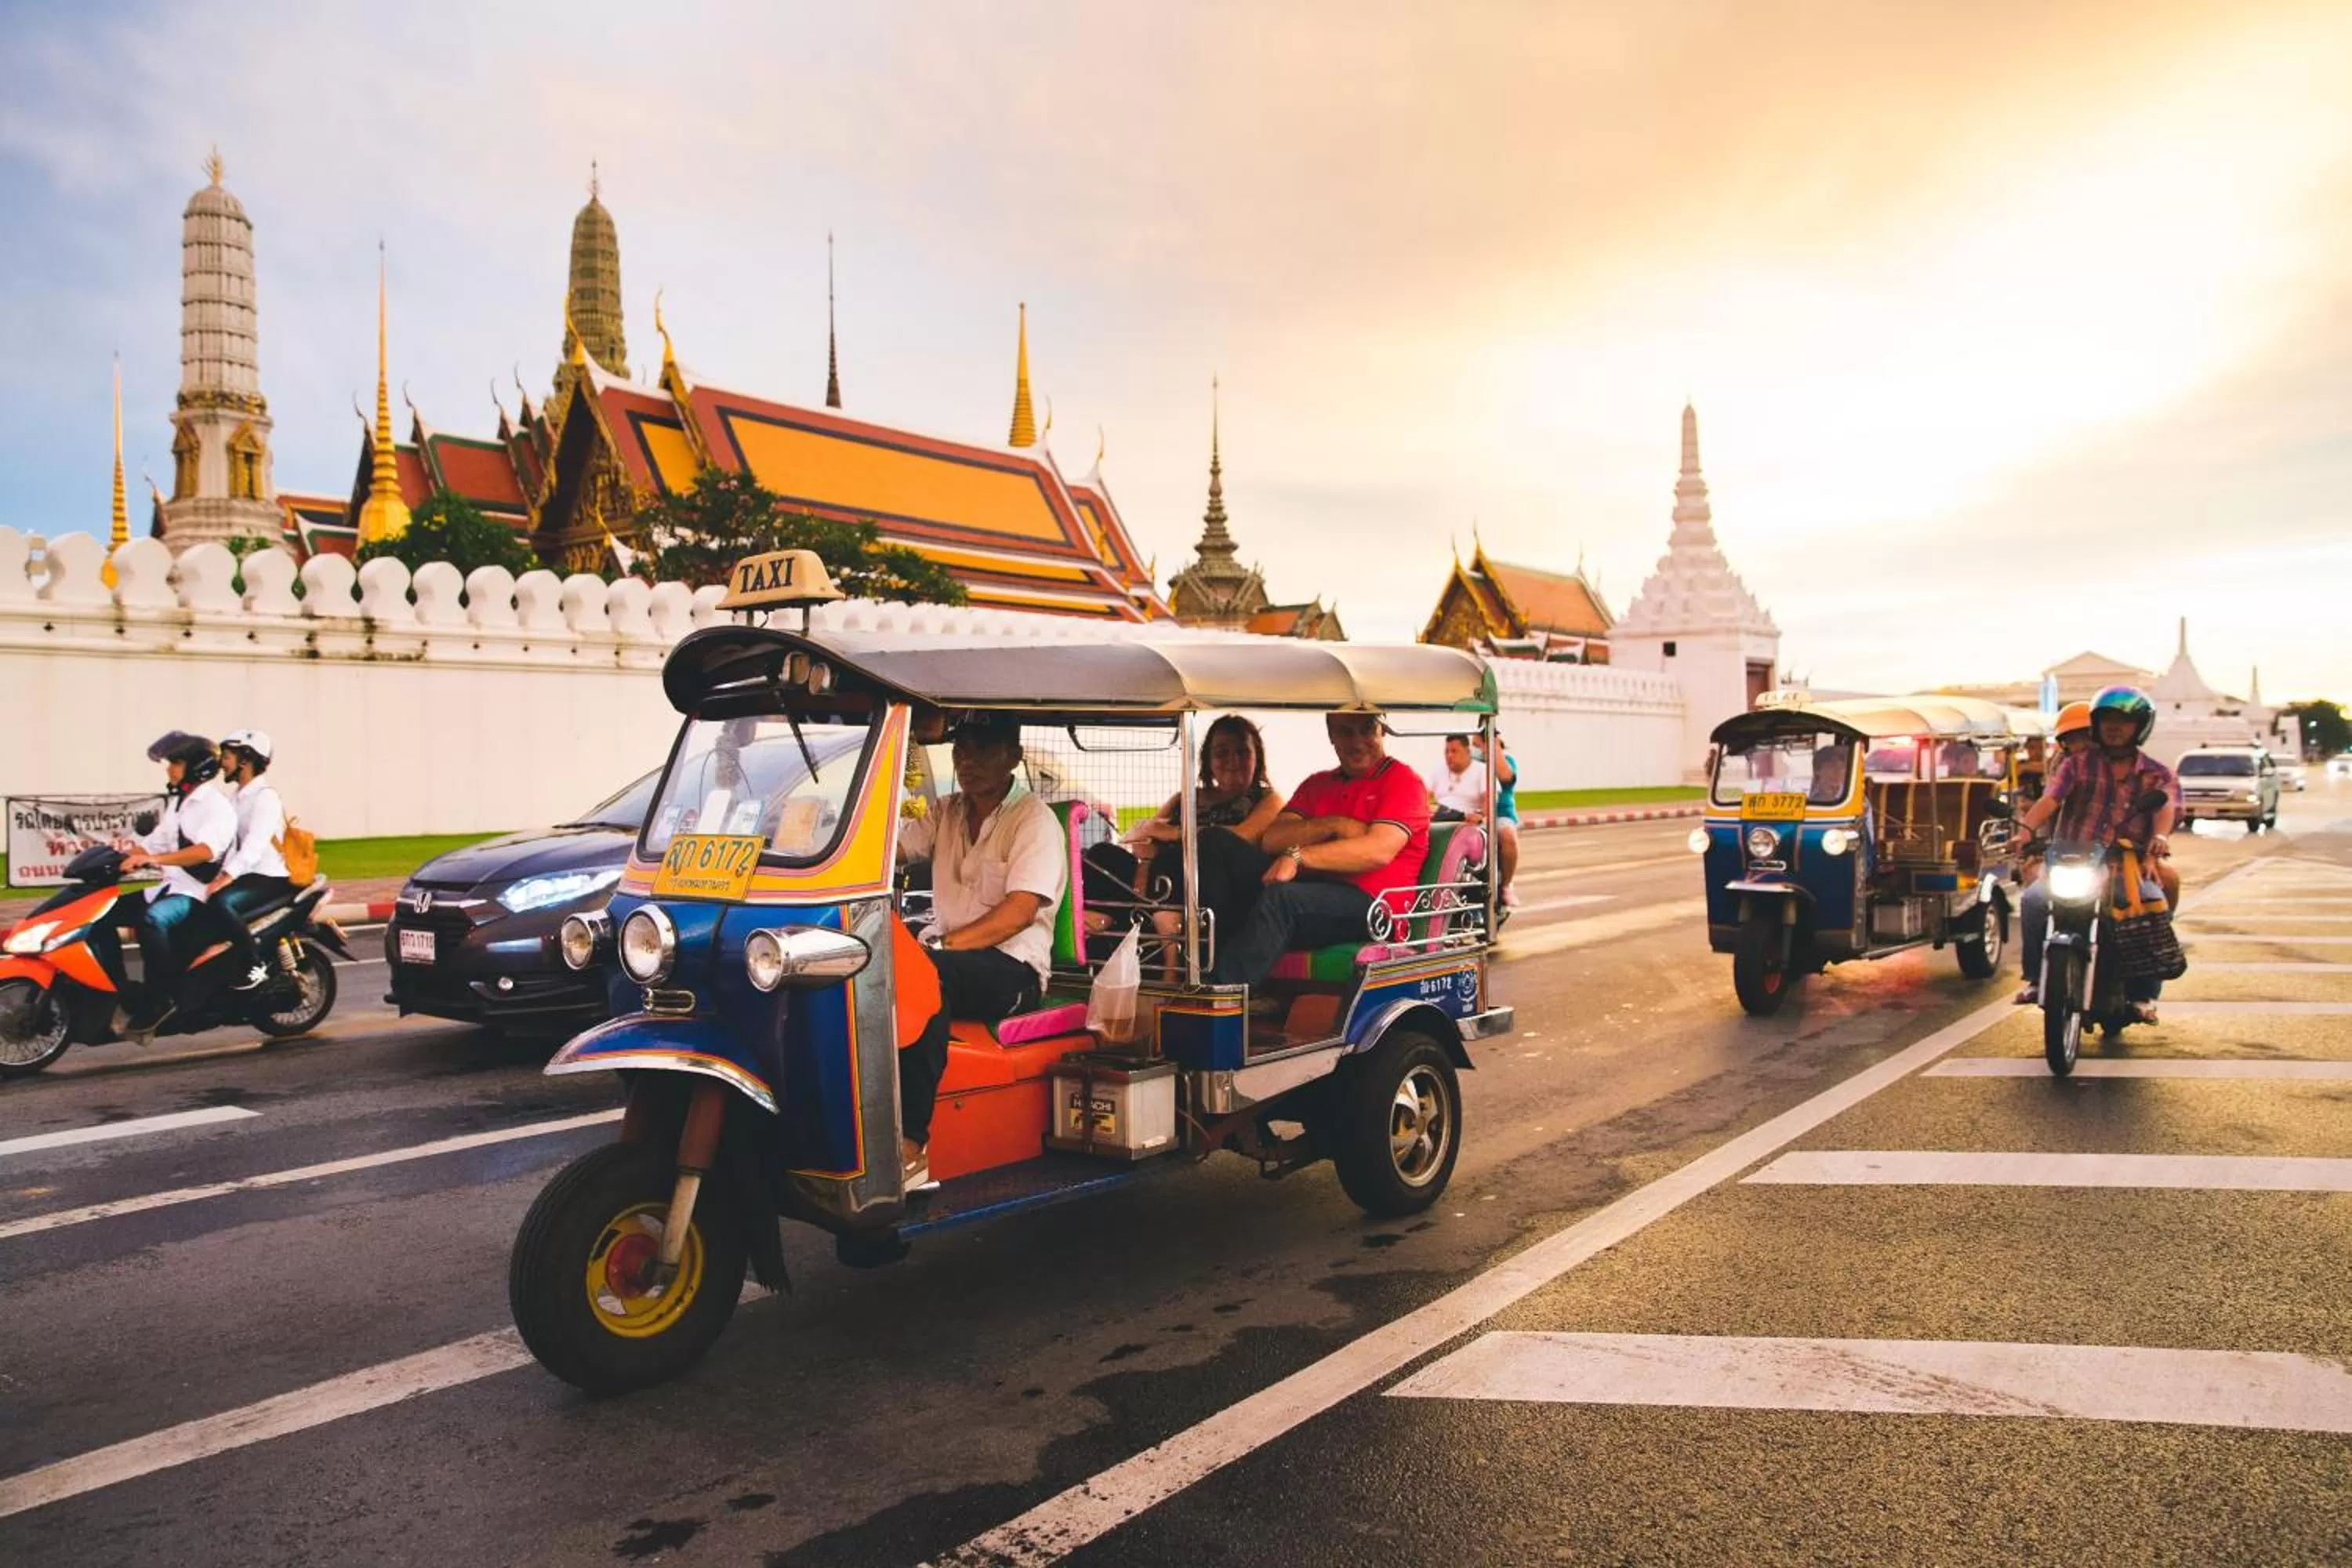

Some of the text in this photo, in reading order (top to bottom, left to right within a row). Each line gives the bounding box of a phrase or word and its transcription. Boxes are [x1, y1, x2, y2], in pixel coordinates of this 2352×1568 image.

[739, 557, 795, 593] TAXI
[1772, 796, 1802, 808] 3772
[699, 840, 754, 878] 6172
[1073, 1098, 1112, 1112] HACHI
